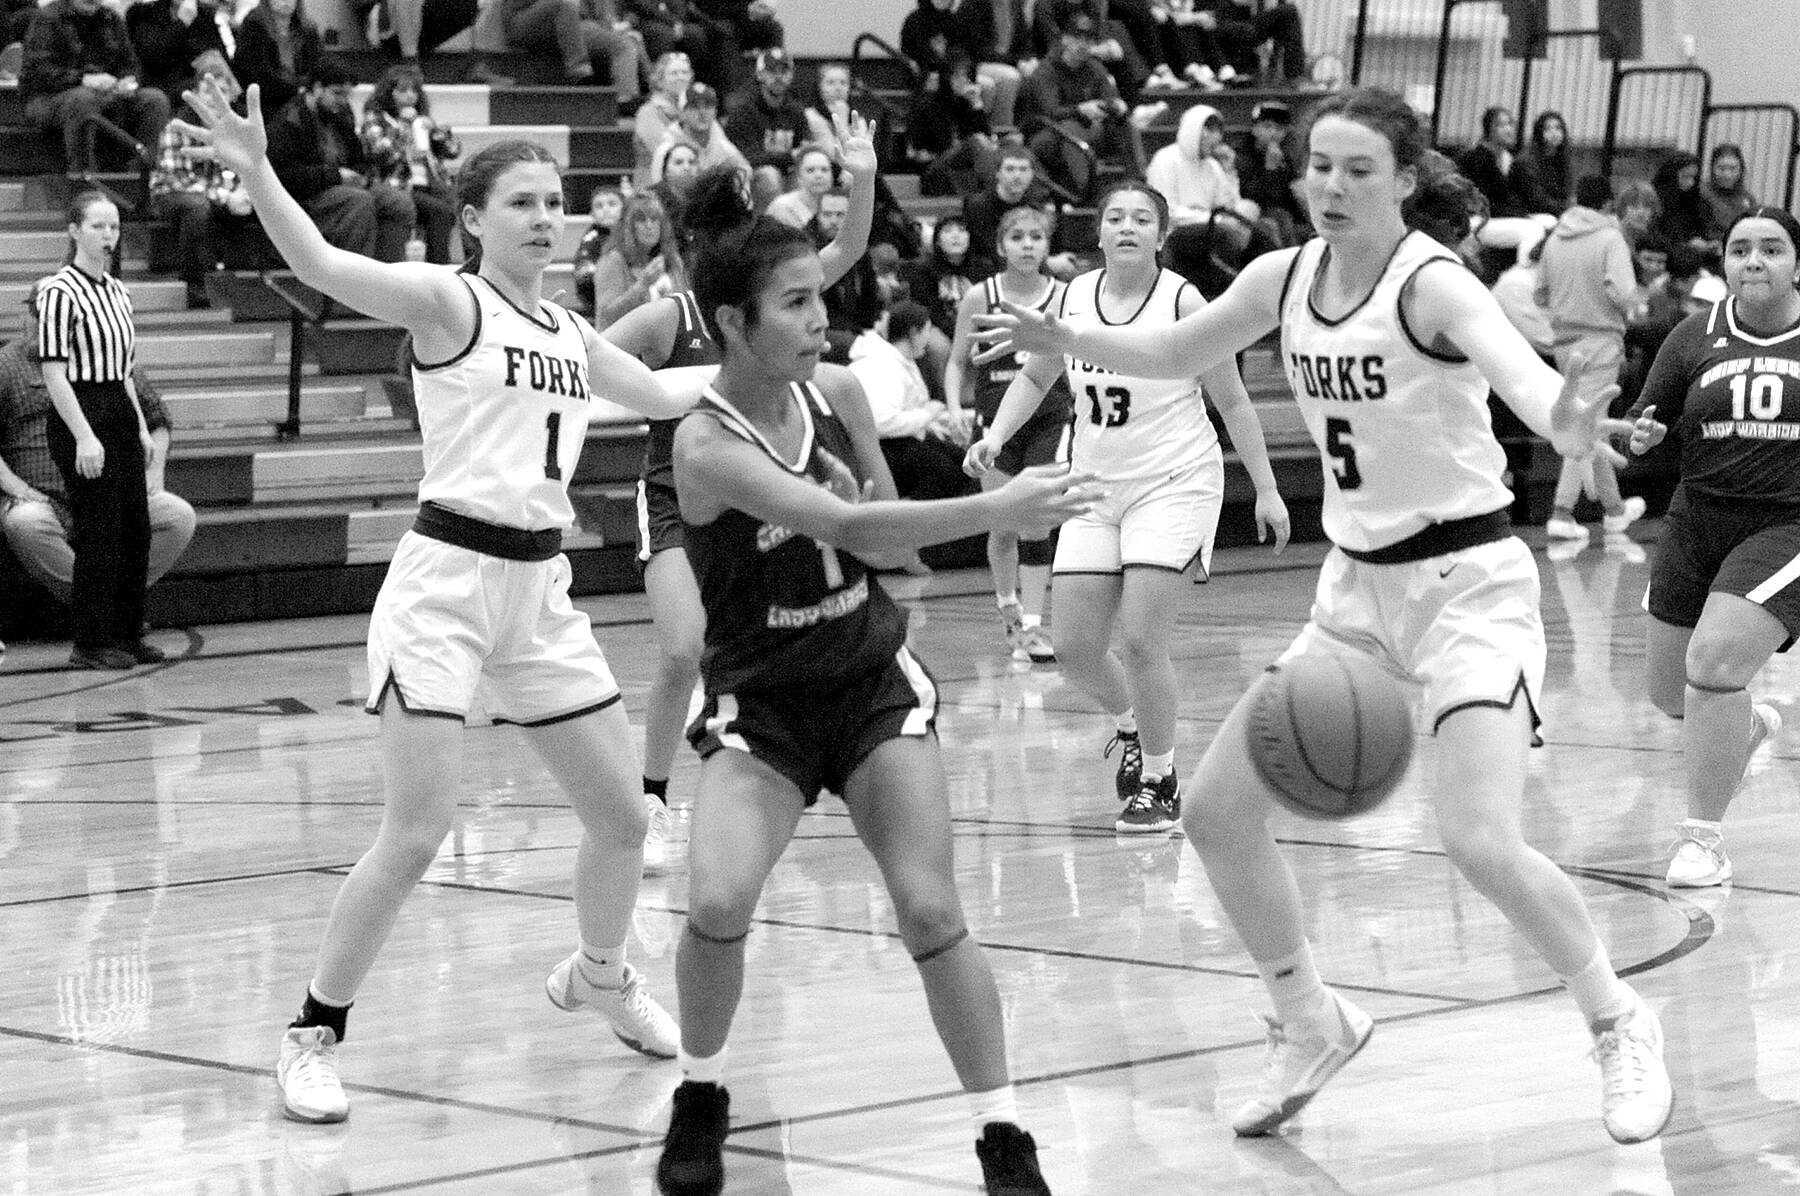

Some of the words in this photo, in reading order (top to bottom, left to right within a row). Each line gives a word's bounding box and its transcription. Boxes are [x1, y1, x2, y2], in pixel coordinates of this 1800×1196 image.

[504, 346, 591, 402] FORK
[1729, 373, 1784, 420] 10
[1085, 385, 1132, 428] 13
[544, 411, 562, 481] 1
[1326, 417, 1363, 490] 5
[813, 538, 845, 590] 1
